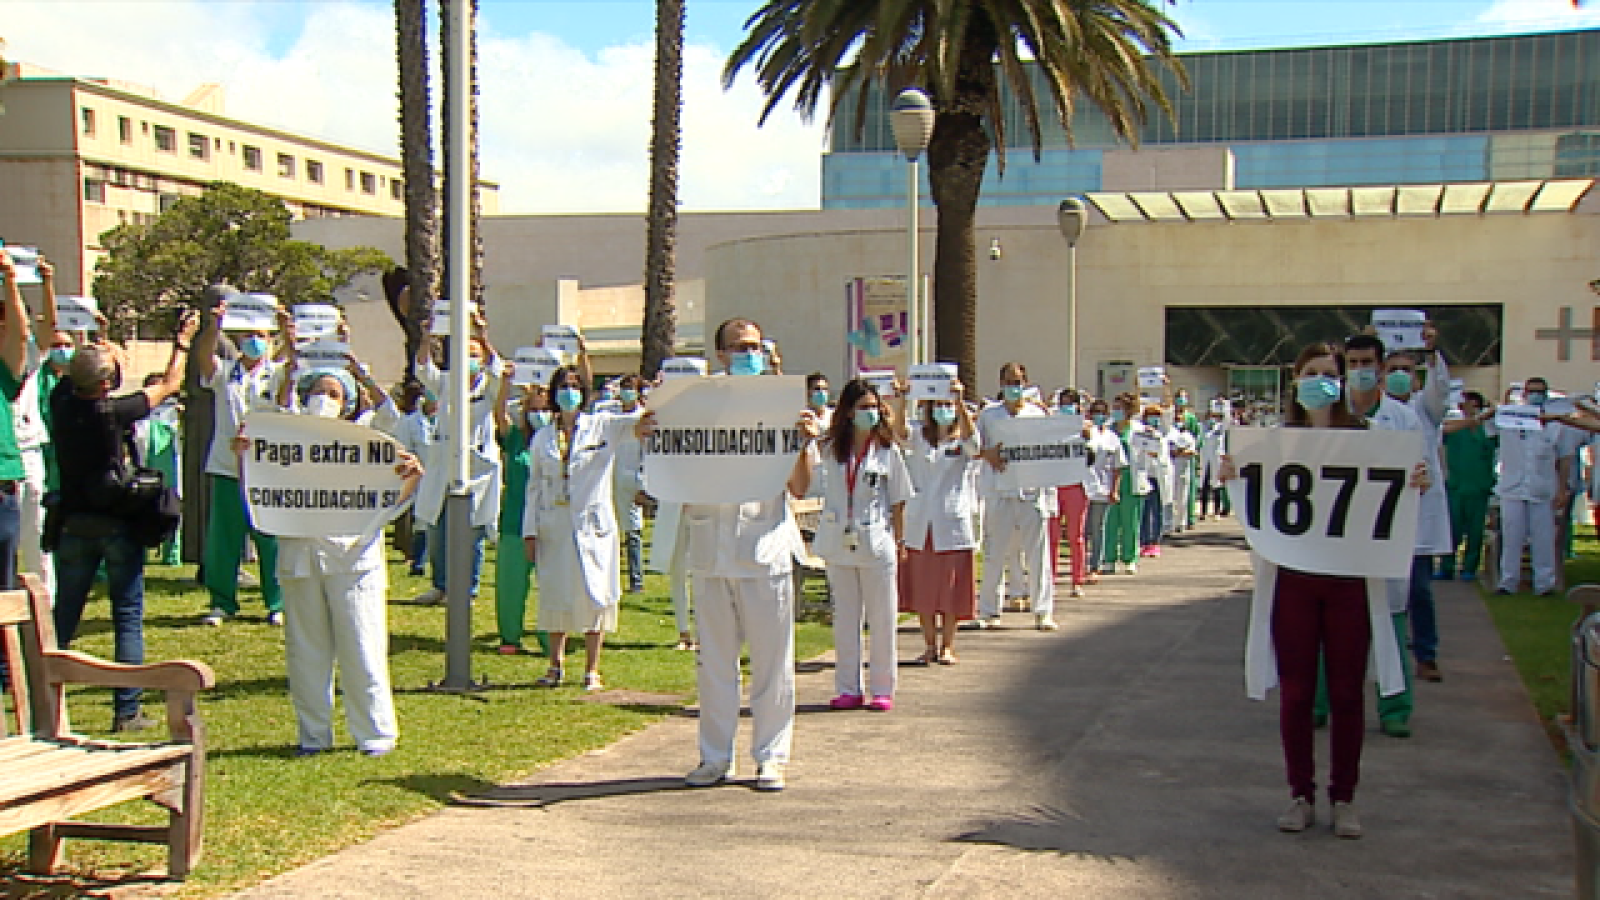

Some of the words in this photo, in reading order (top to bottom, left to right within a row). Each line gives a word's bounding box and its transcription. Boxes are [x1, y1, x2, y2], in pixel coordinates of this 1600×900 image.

[254, 439, 303, 467] Paga
[310, 440, 361, 464] extra
[367, 440, 396, 464] NO
[1239, 462, 1407, 541] 1877
